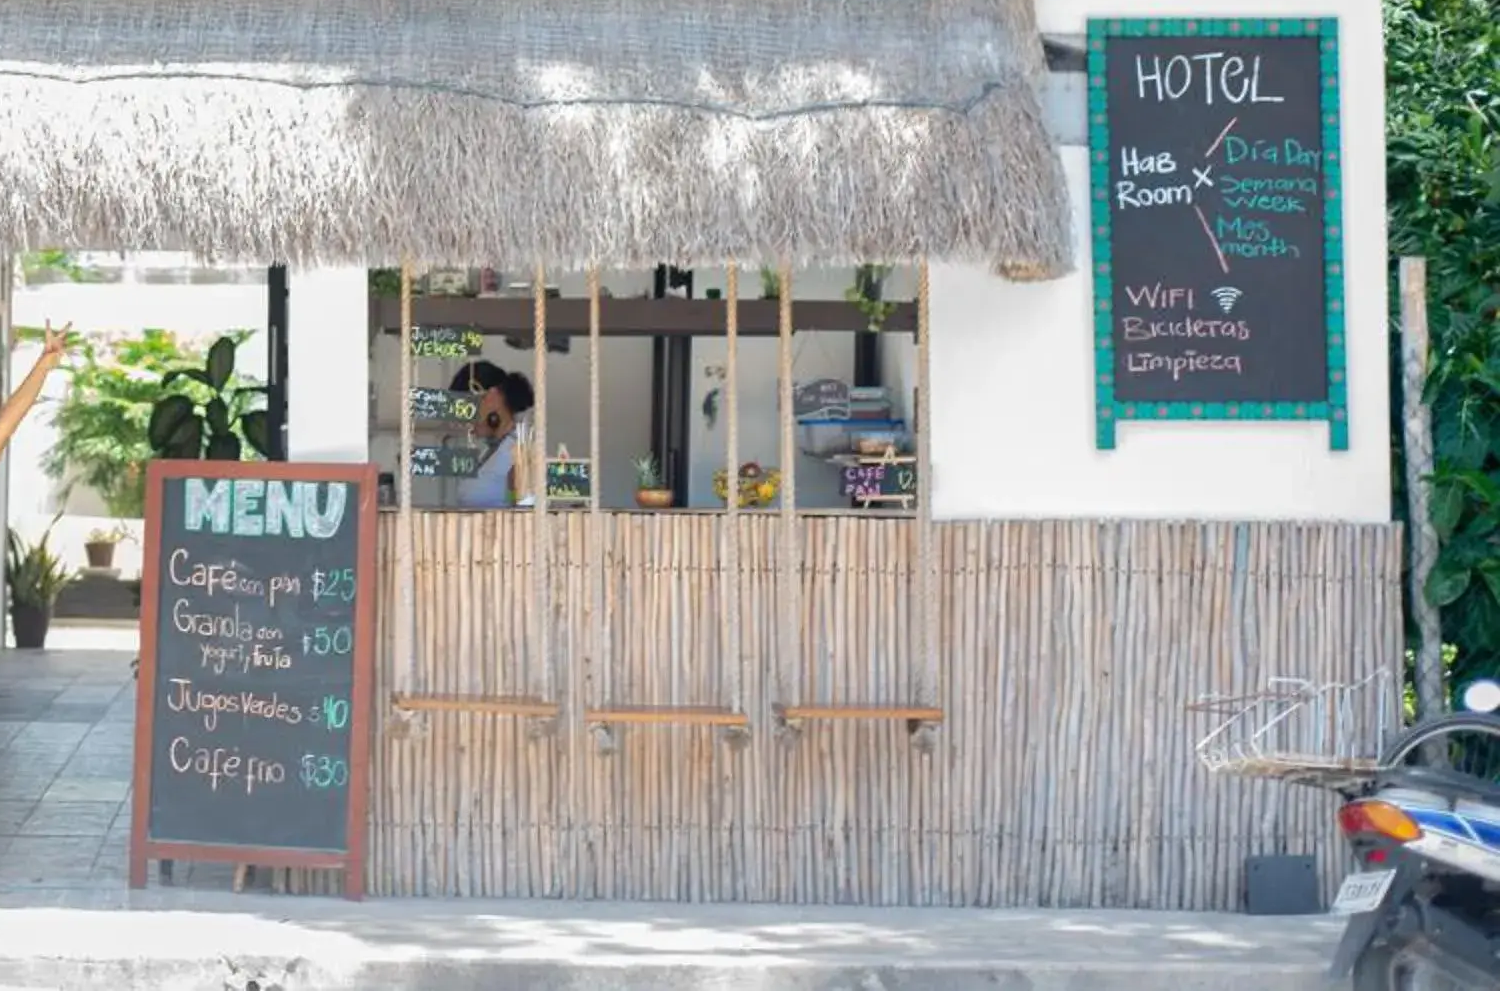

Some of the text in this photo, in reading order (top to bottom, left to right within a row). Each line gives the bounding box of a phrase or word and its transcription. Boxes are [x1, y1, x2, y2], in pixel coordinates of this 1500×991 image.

[1284, 138, 1321, 171] Day
[1116, 180, 1193, 209] Room
[184, 478, 348, 538] MENU
[310, 567, 357, 602] $25
[173, 598, 252, 642] Granola
[167, 678, 239, 731] Jugos
[300, 752, 348, 788] $30
